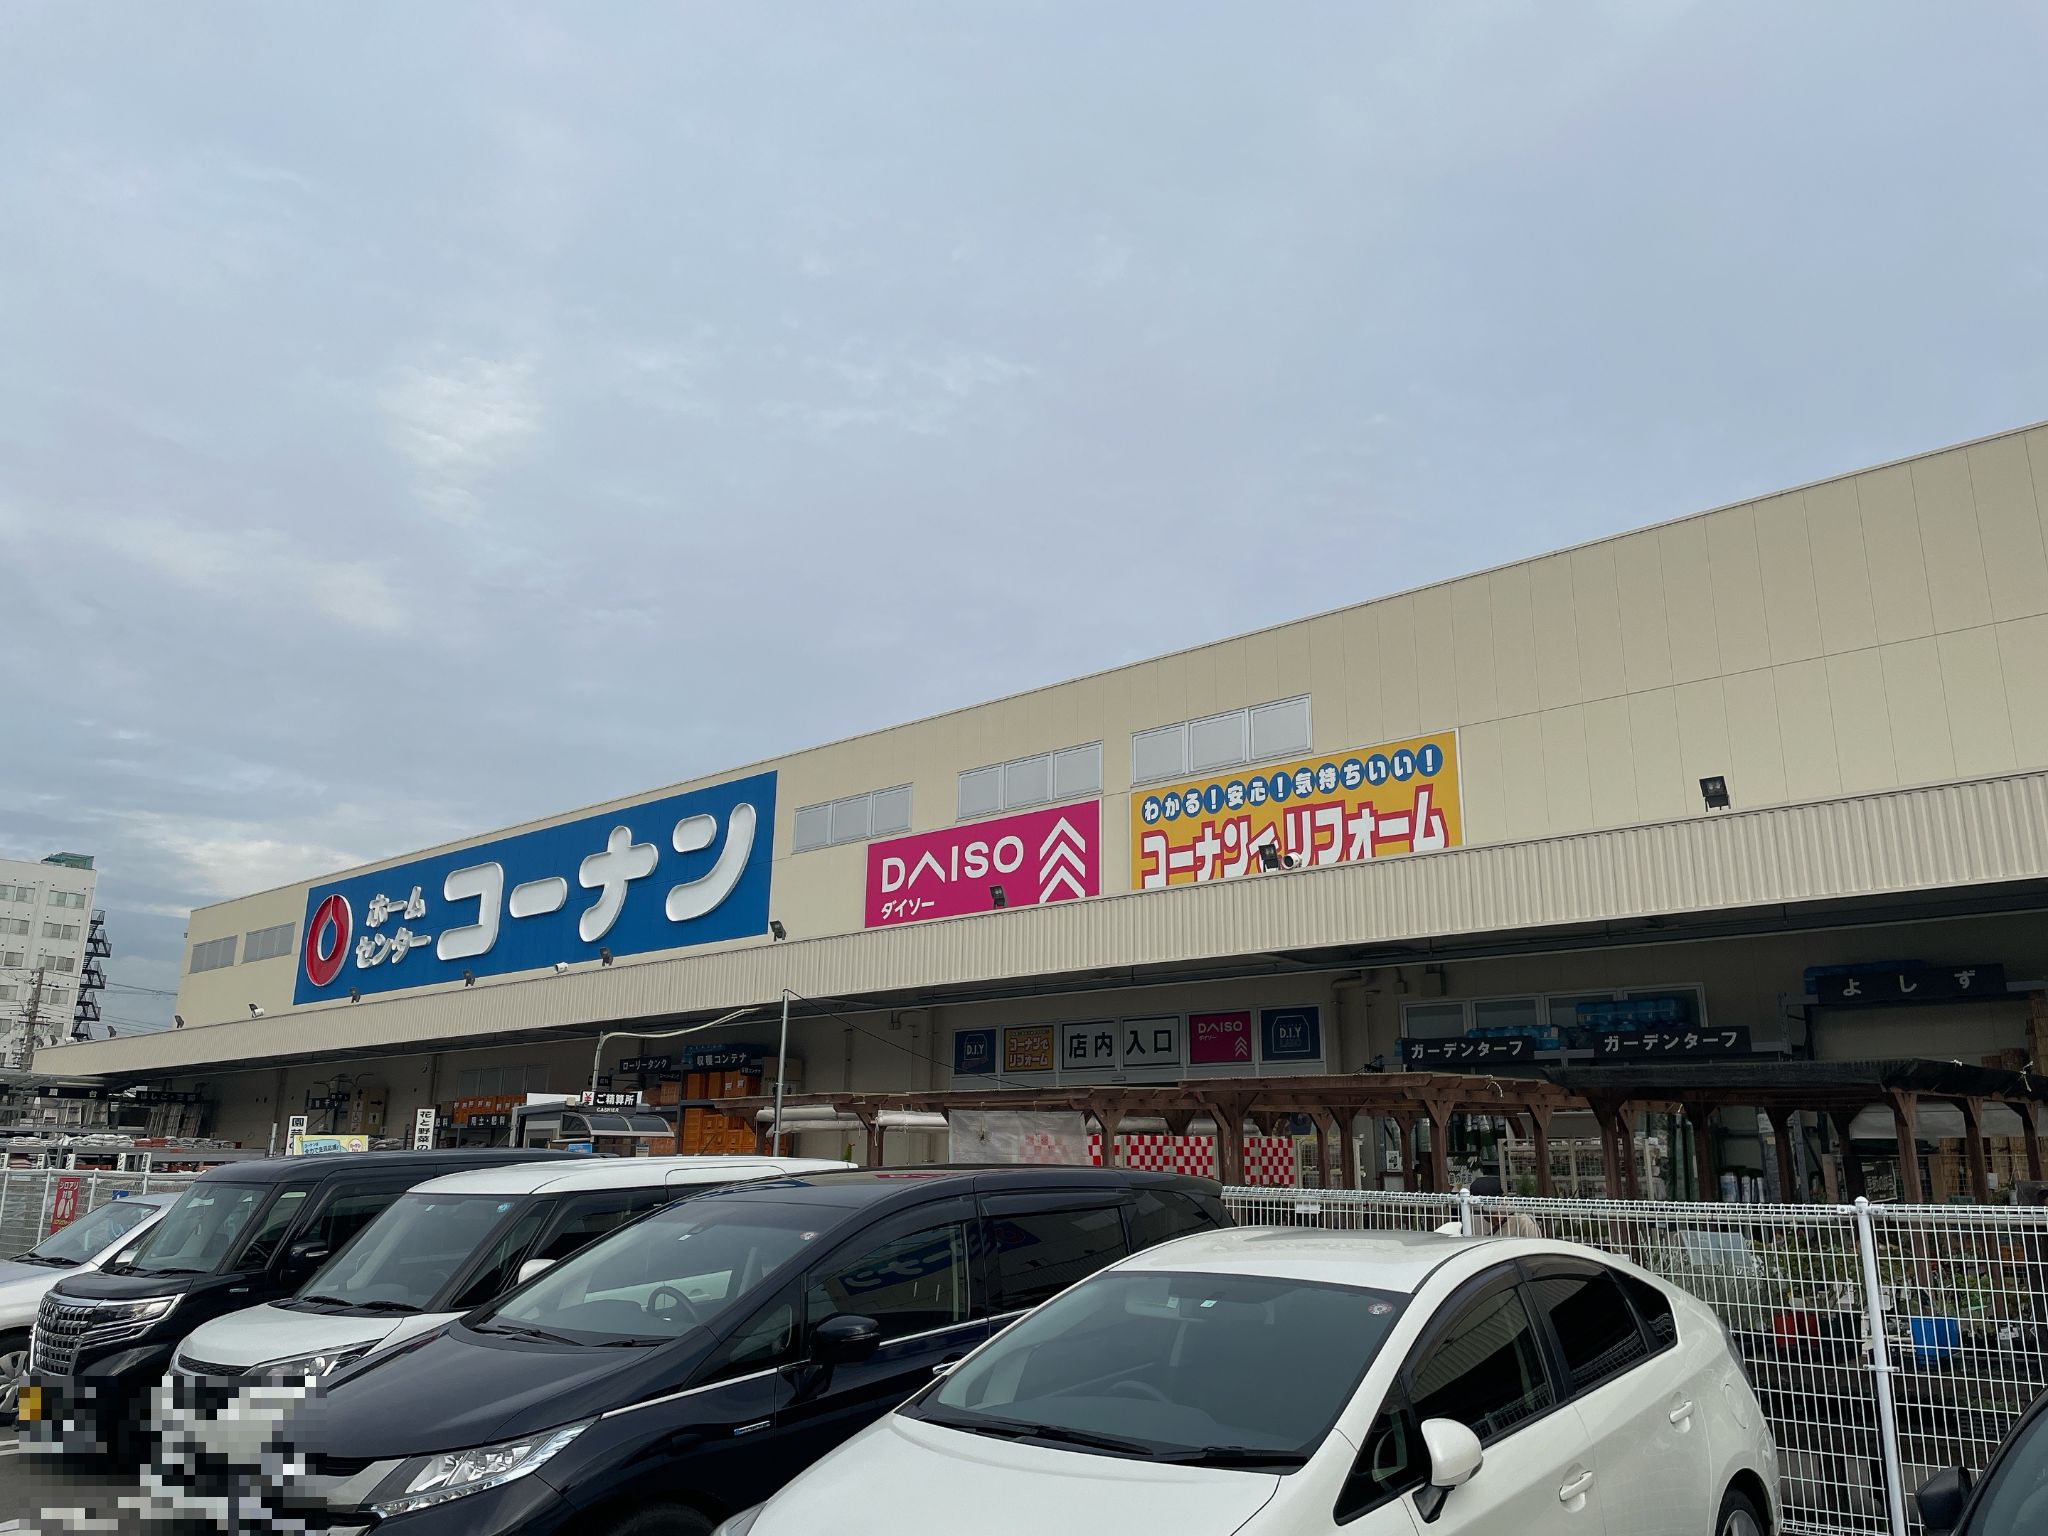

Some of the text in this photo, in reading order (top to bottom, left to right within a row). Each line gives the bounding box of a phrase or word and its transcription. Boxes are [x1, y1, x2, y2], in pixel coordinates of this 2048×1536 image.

[881, 835, 1024, 893] DAISO
[437, 803, 757, 962] コーナン
[366, 886, 426, 928] ホーム
[881, 897, 935, 920] ダイソー
[356, 927, 432, 969] センター
[1842, 969, 1976, 997] よしず
[1198, 1021, 1243, 1034] DAISO
[1279, 1026, 1302, 1039] D.I.Y
[966, 1043, 985, 1056] D.I.Y
[1009, 1036, 1049, 1053] コーナンで
[1411, 1040, 1524, 1060] ガーデンターフ
[1603, 1031, 1738, 1053] ガーデンターフ
[622, 1058, 667, 1071] ローリータンク
[1009, 1053, 1049, 1068] リフォーム
[596, 1093, 635, 1106] ご精算所
[58, 1181, 80, 1190] シロアリ
